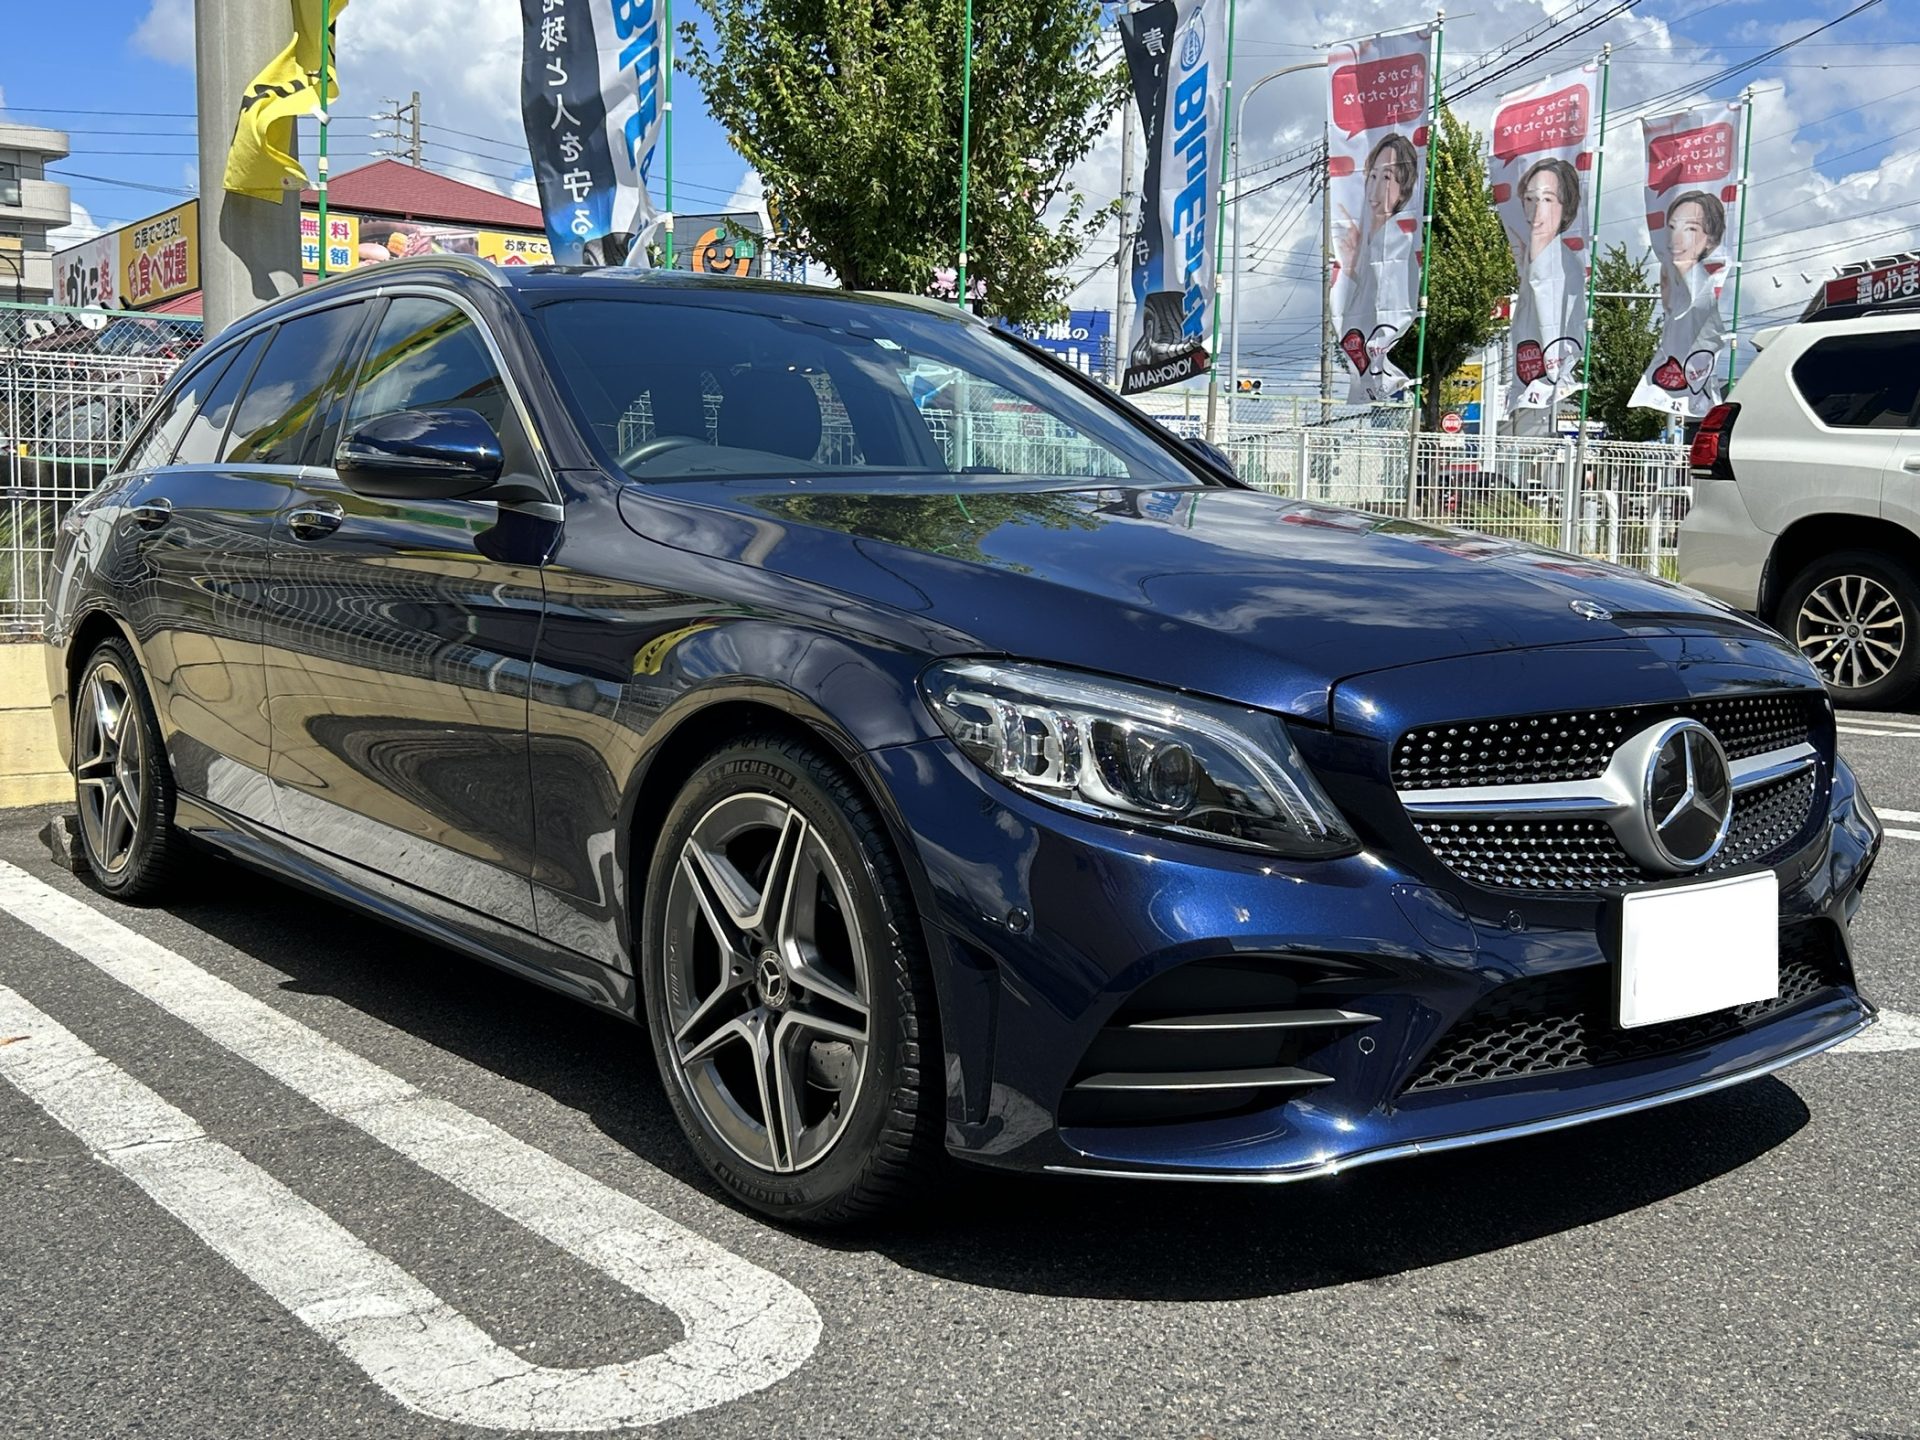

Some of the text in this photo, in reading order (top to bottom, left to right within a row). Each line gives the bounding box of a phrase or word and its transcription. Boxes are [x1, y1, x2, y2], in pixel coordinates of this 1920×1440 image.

[138, 240, 188, 297] 食べ放題
[301, 246, 350, 266] 半額
[724, 760, 794, 786] MICHELIN
[716, 1165, 786, 1205] MICHELIN
